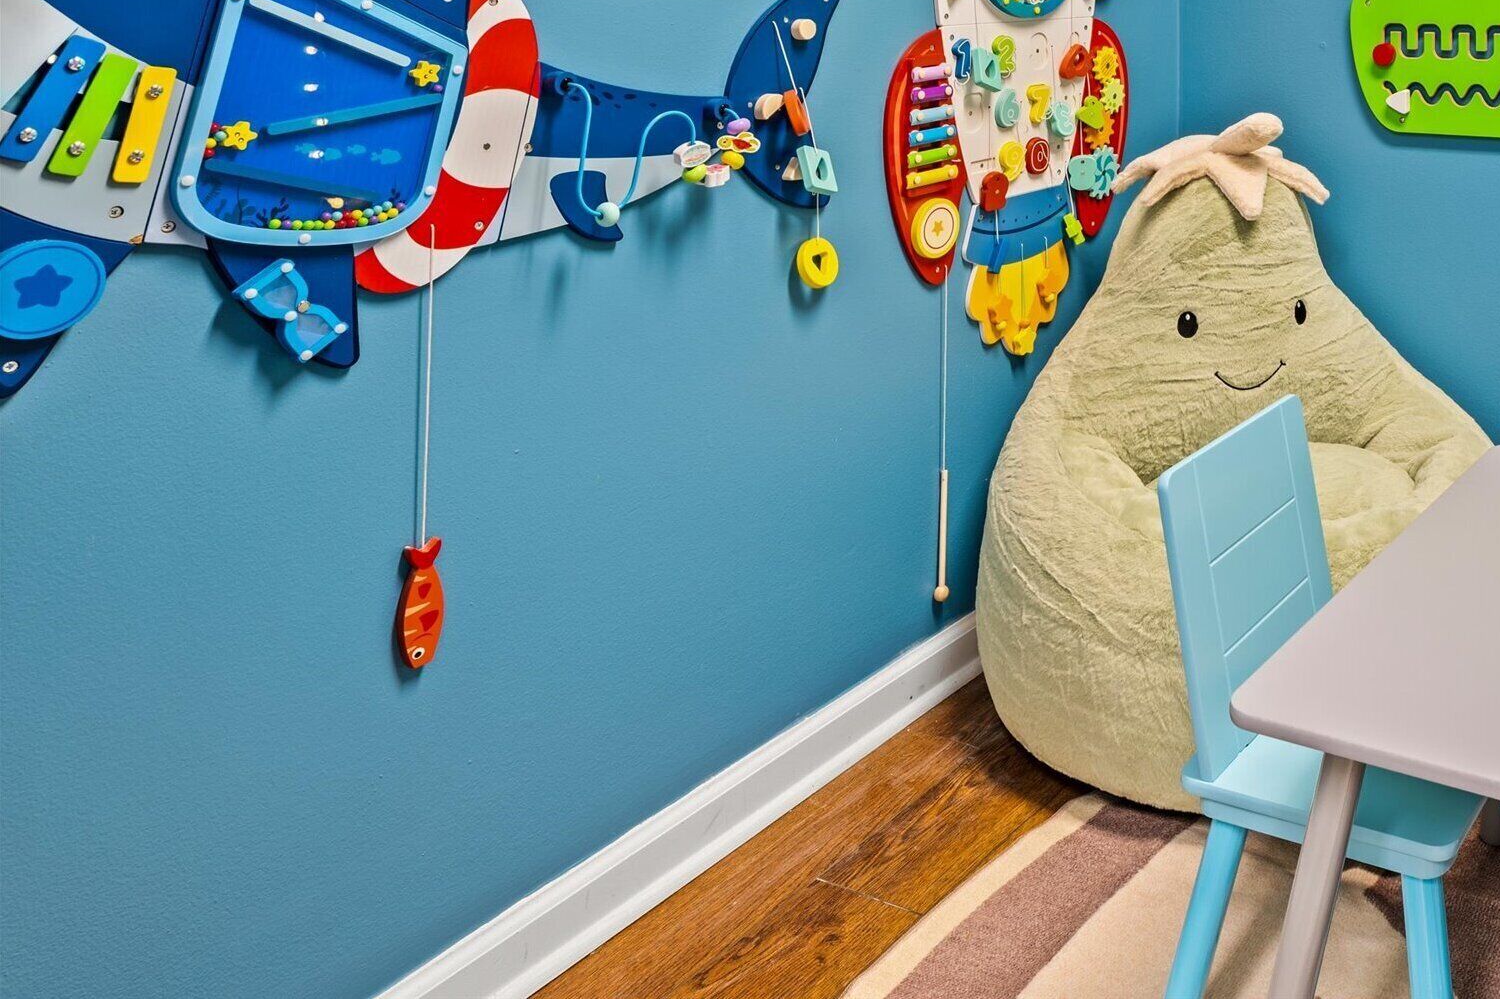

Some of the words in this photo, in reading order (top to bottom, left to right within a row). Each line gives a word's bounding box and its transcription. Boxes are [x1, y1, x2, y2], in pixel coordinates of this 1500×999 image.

[951, 38, 972, 80] 1
[992, 34, 1017, 78] 2
[994, 88, 1022, 128] 6
[1026, 83, 1052, 125] 7
[999, 140, 1026, 182] 9
